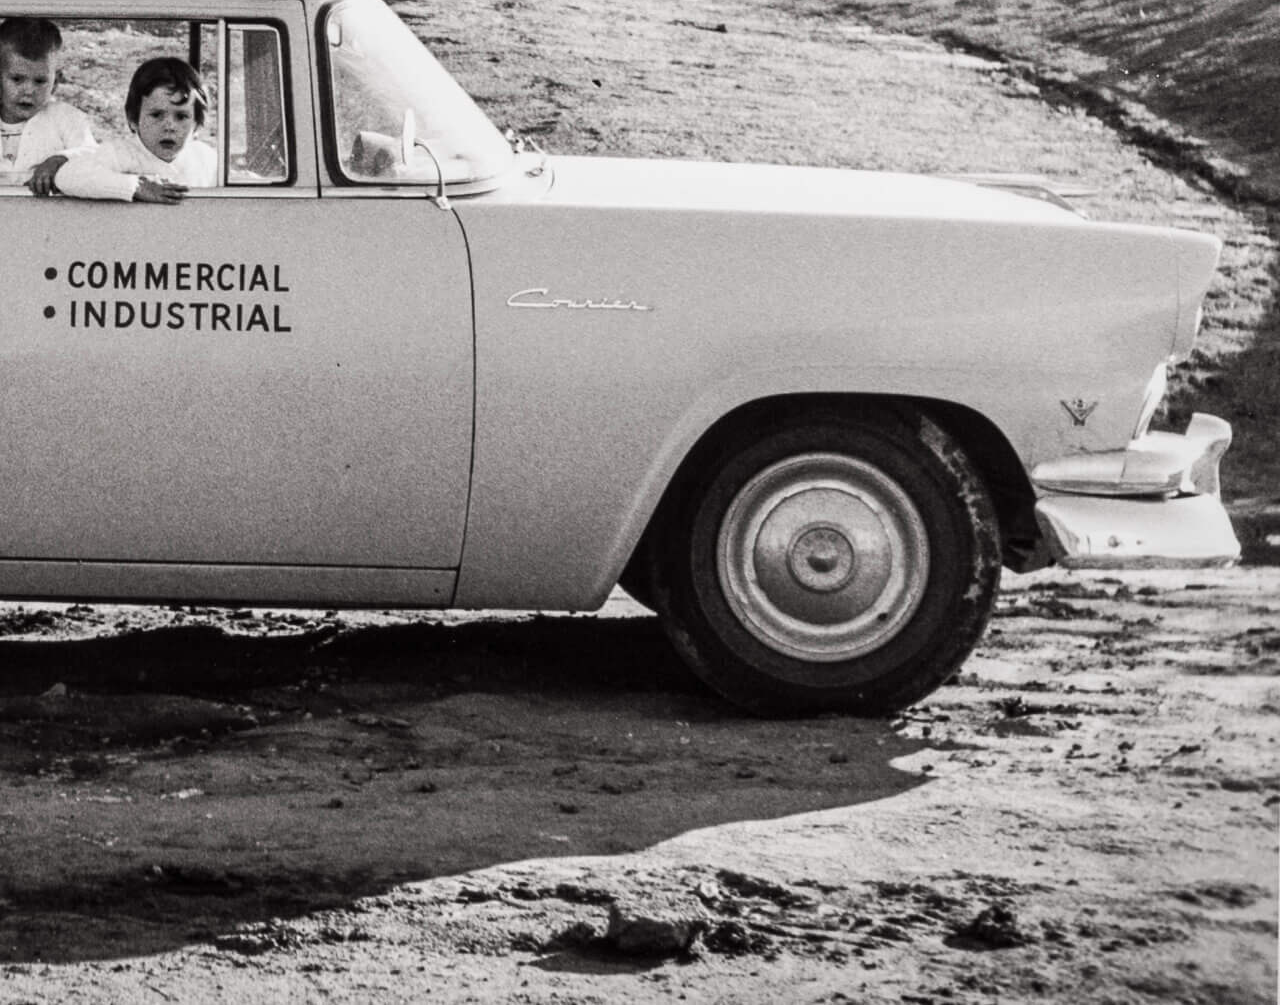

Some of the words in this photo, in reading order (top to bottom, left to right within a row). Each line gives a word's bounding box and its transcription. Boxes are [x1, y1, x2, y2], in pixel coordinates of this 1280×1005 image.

[67, 260, 290, 293] COMMERCIAL
[506, 287, 656, 312] Courier
[69, 300, 292, 333] INDUSTRIAL
